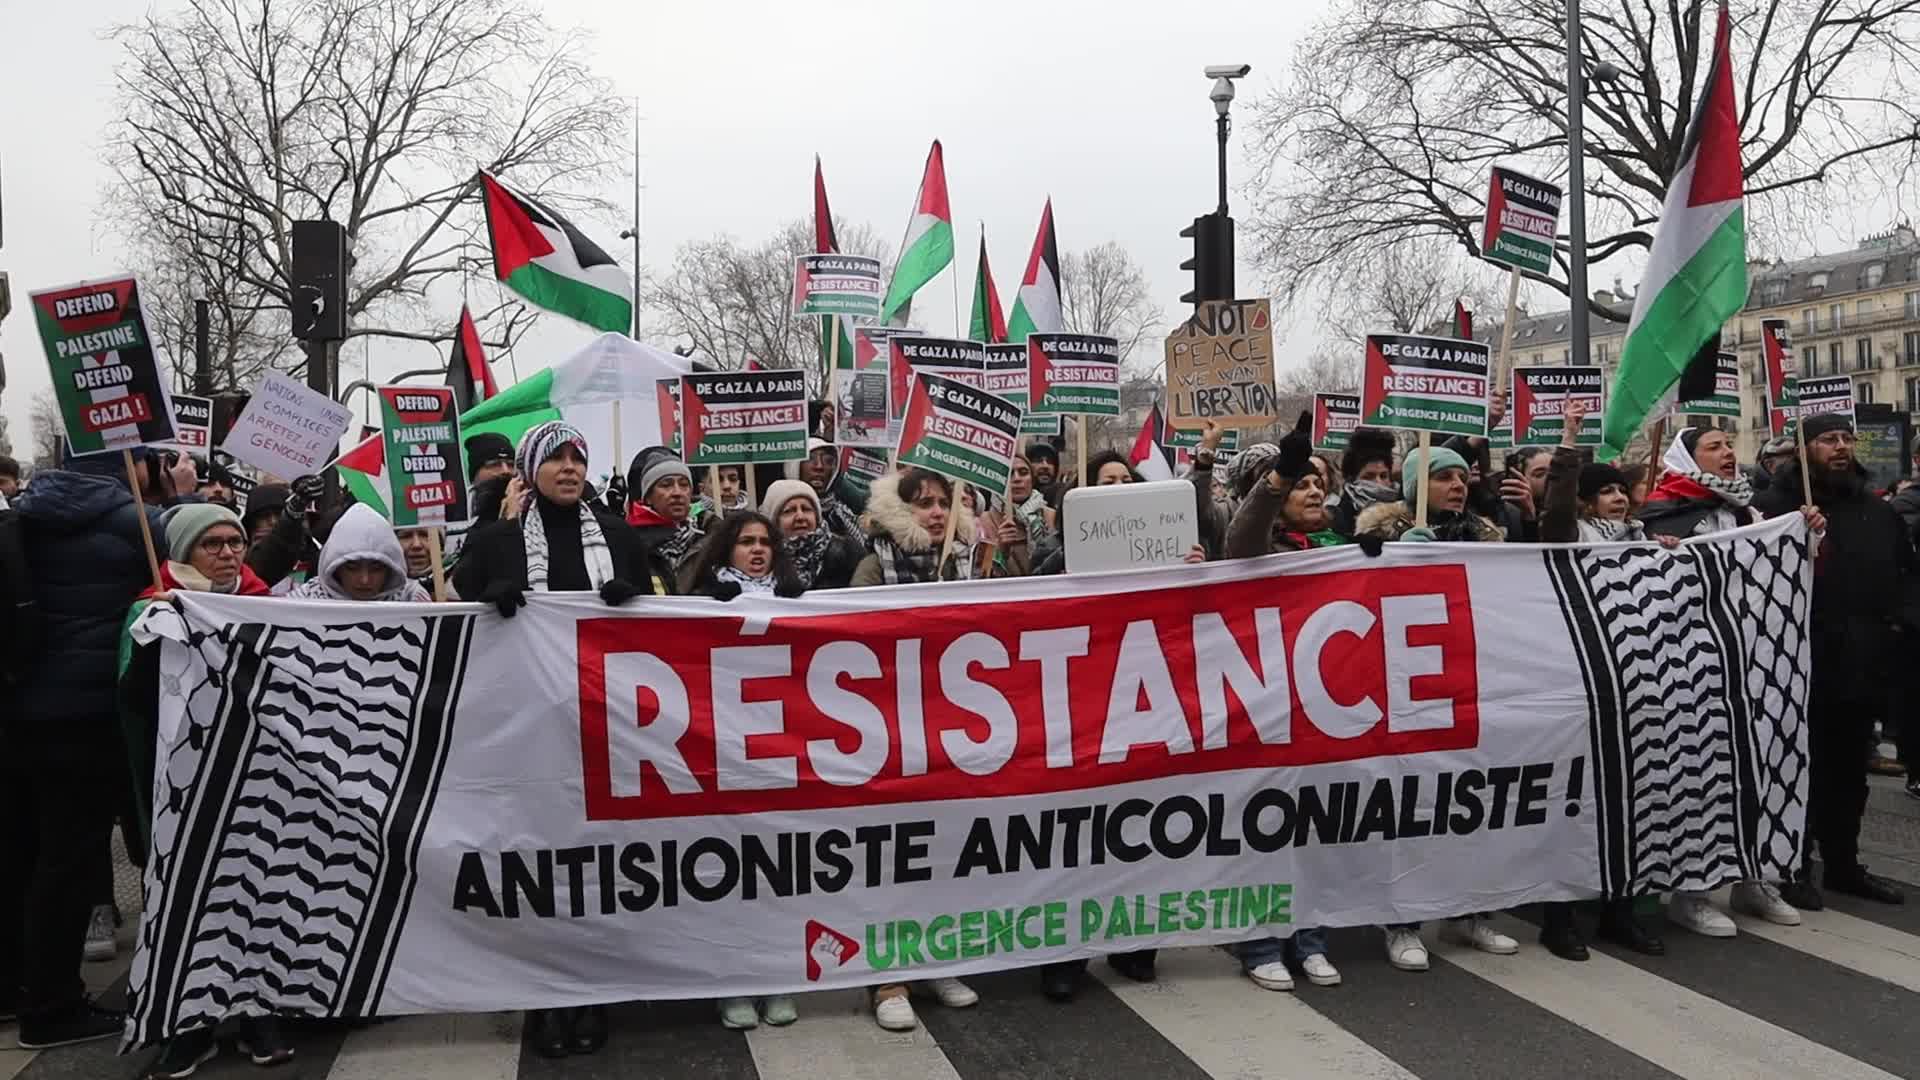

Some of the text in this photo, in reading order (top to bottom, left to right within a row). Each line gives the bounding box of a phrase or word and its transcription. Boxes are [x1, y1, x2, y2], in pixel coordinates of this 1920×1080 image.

[1503, 178, 1514, 191] DE
[1514, 183, 1535, 199] GAZA
[1535, 190, 1542, 202] A
[805, 261, 879, 273] DE GAZA A PARIS
[55, 292, 115, 318] DEFEND
[1189, 303, 1252, 337] NOT
[56, 325, 136, 358] PALESTINE
[1042, 341, 1117, 356] DE GAZA A PARIS
[903, 345, 983, 361] DE GAZA A PARIS
[986, 352, 1008, 362] AZA
[1010, 352, 1017, 361] A
[1173, 337, 1267, 368] PEACE
[1382, 344, 1487, 366] DE GAZA A PARIS
[75, 365, 134, 389] DEFEND
[1175, 366, 1265, 387] WE WANT
[1527, 375, 1601, 385] DE GAZA A PARIS
[696, 380, 803, 395] DE GAZA A PARIS
[1479, 381, 1484, 396] !
[1820, 385, 1827, 393] A
[89, 399, 144, 425] GAZA !
[175, 405, 208, 419] PARIS
[396, 395, 440, 411] DEFEND
[929, 384, 1018, 428] DE GAZA A PARIS
[1336, 400, 1356, 408] GAZA
[1528, 398, 1595, 415] RÉSISTCE
[263, 401, 332, 437] COMPLICES
[700, 408, 793, 429] RÉSISTANCE
[797, 406, 802, 420] !
[1395, 408, 1439, 420] URGENCE
[1440, 412, 1484, 425] PALESTINE
[247, 413, 302, 442] ARRETEZ
[392, 425, 450, 443] PALESTINE
[250, 433, 315, 468] GENOCIDE
[714, 440, 805, 453] URGENCE PALESTINE
[403, 457, 446, 472] DEFEND
[930, 449, 1007, 485] URGENCE PALESTINE
[411, 485, 451, 504] GAZA !
[1160, 512, 1185, 526] POUR
[1129, 536, 1186, 561] ISRAEL
[603, 593, 1454, 798] RÉSISTANCE
[453, 756, 1585, 918] ANTISIONISTE ANTICOLONIALISTE !
[865, 884, 1295, 971] URGENCE PALESTINE
